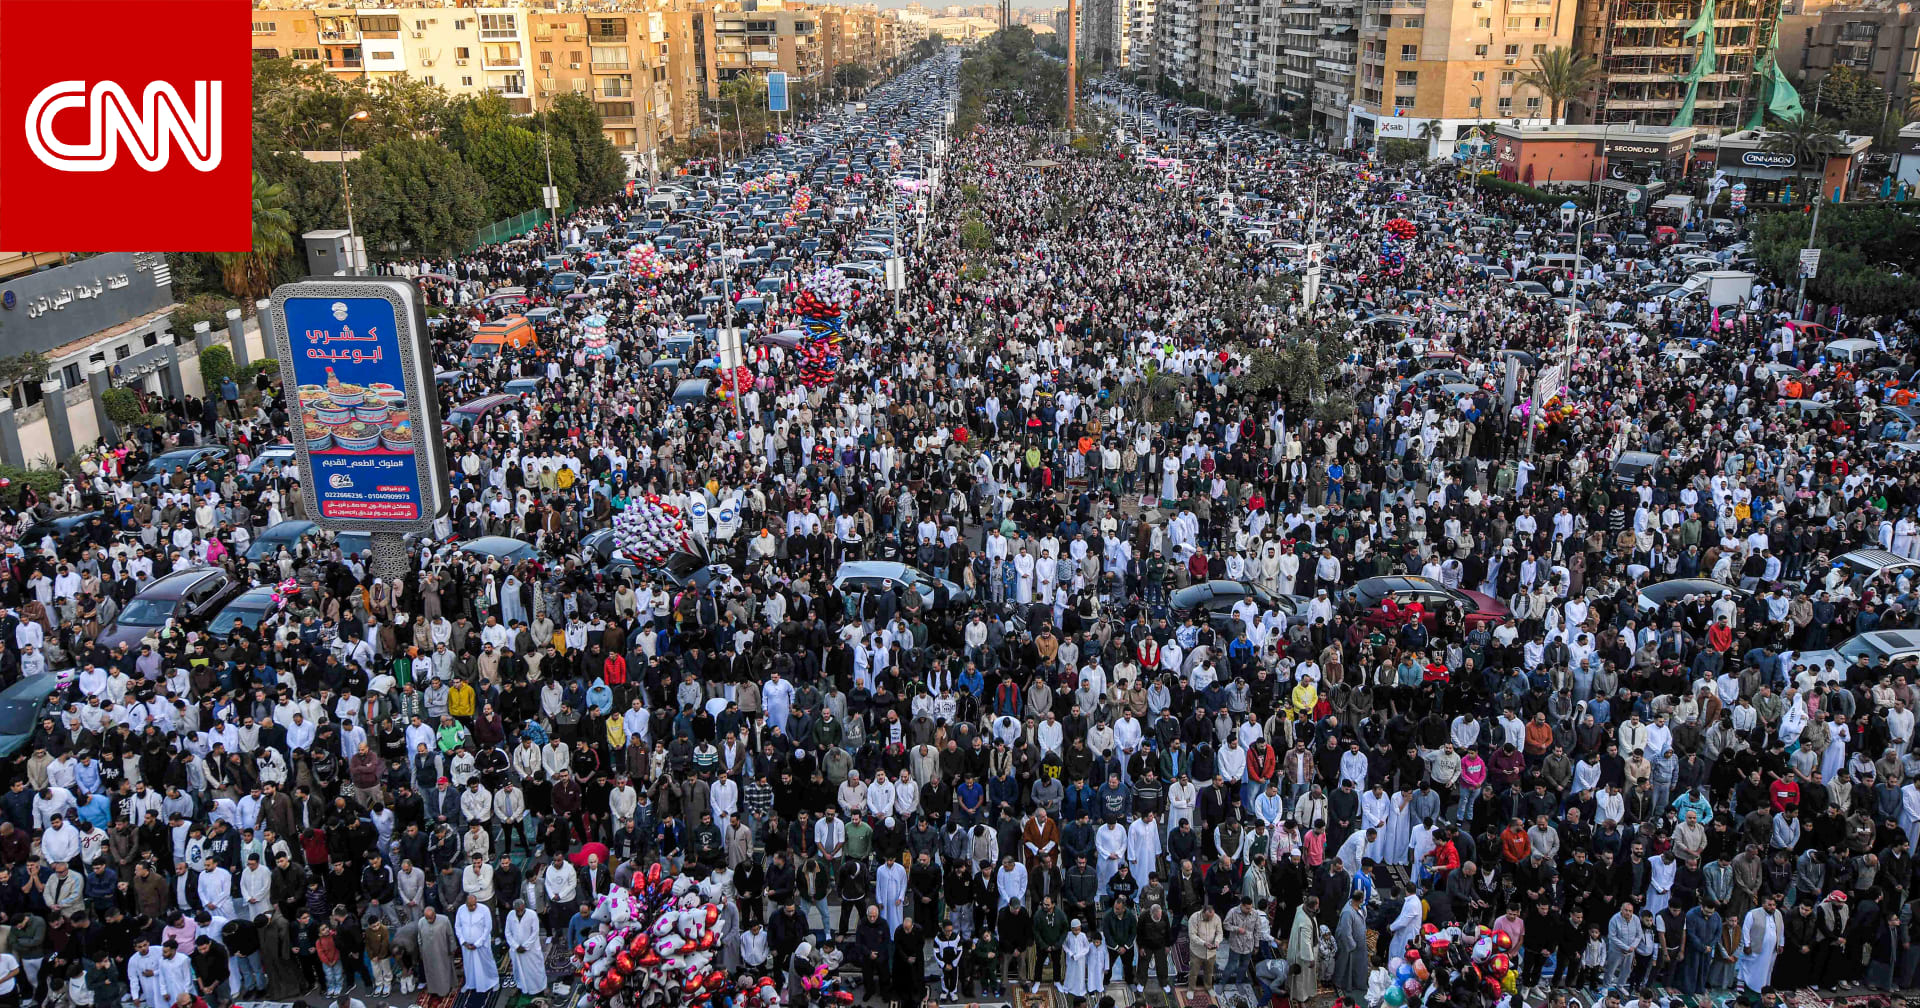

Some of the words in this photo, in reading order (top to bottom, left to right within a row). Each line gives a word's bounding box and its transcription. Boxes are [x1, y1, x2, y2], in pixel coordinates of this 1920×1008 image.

[1614, 145, 1643, 153] SECOND
[1643, 146, 1660, 154] CUP
[1746, 154, 1792, 164] CINNABON
[75, 278, 104, 299] شرطة
[107, 273, 129, 290] نقطة
[28, 288, 75, 319] الشيراتون
[306, 325, 377, 344] كشري
[337, 474, 351, 483] 24
